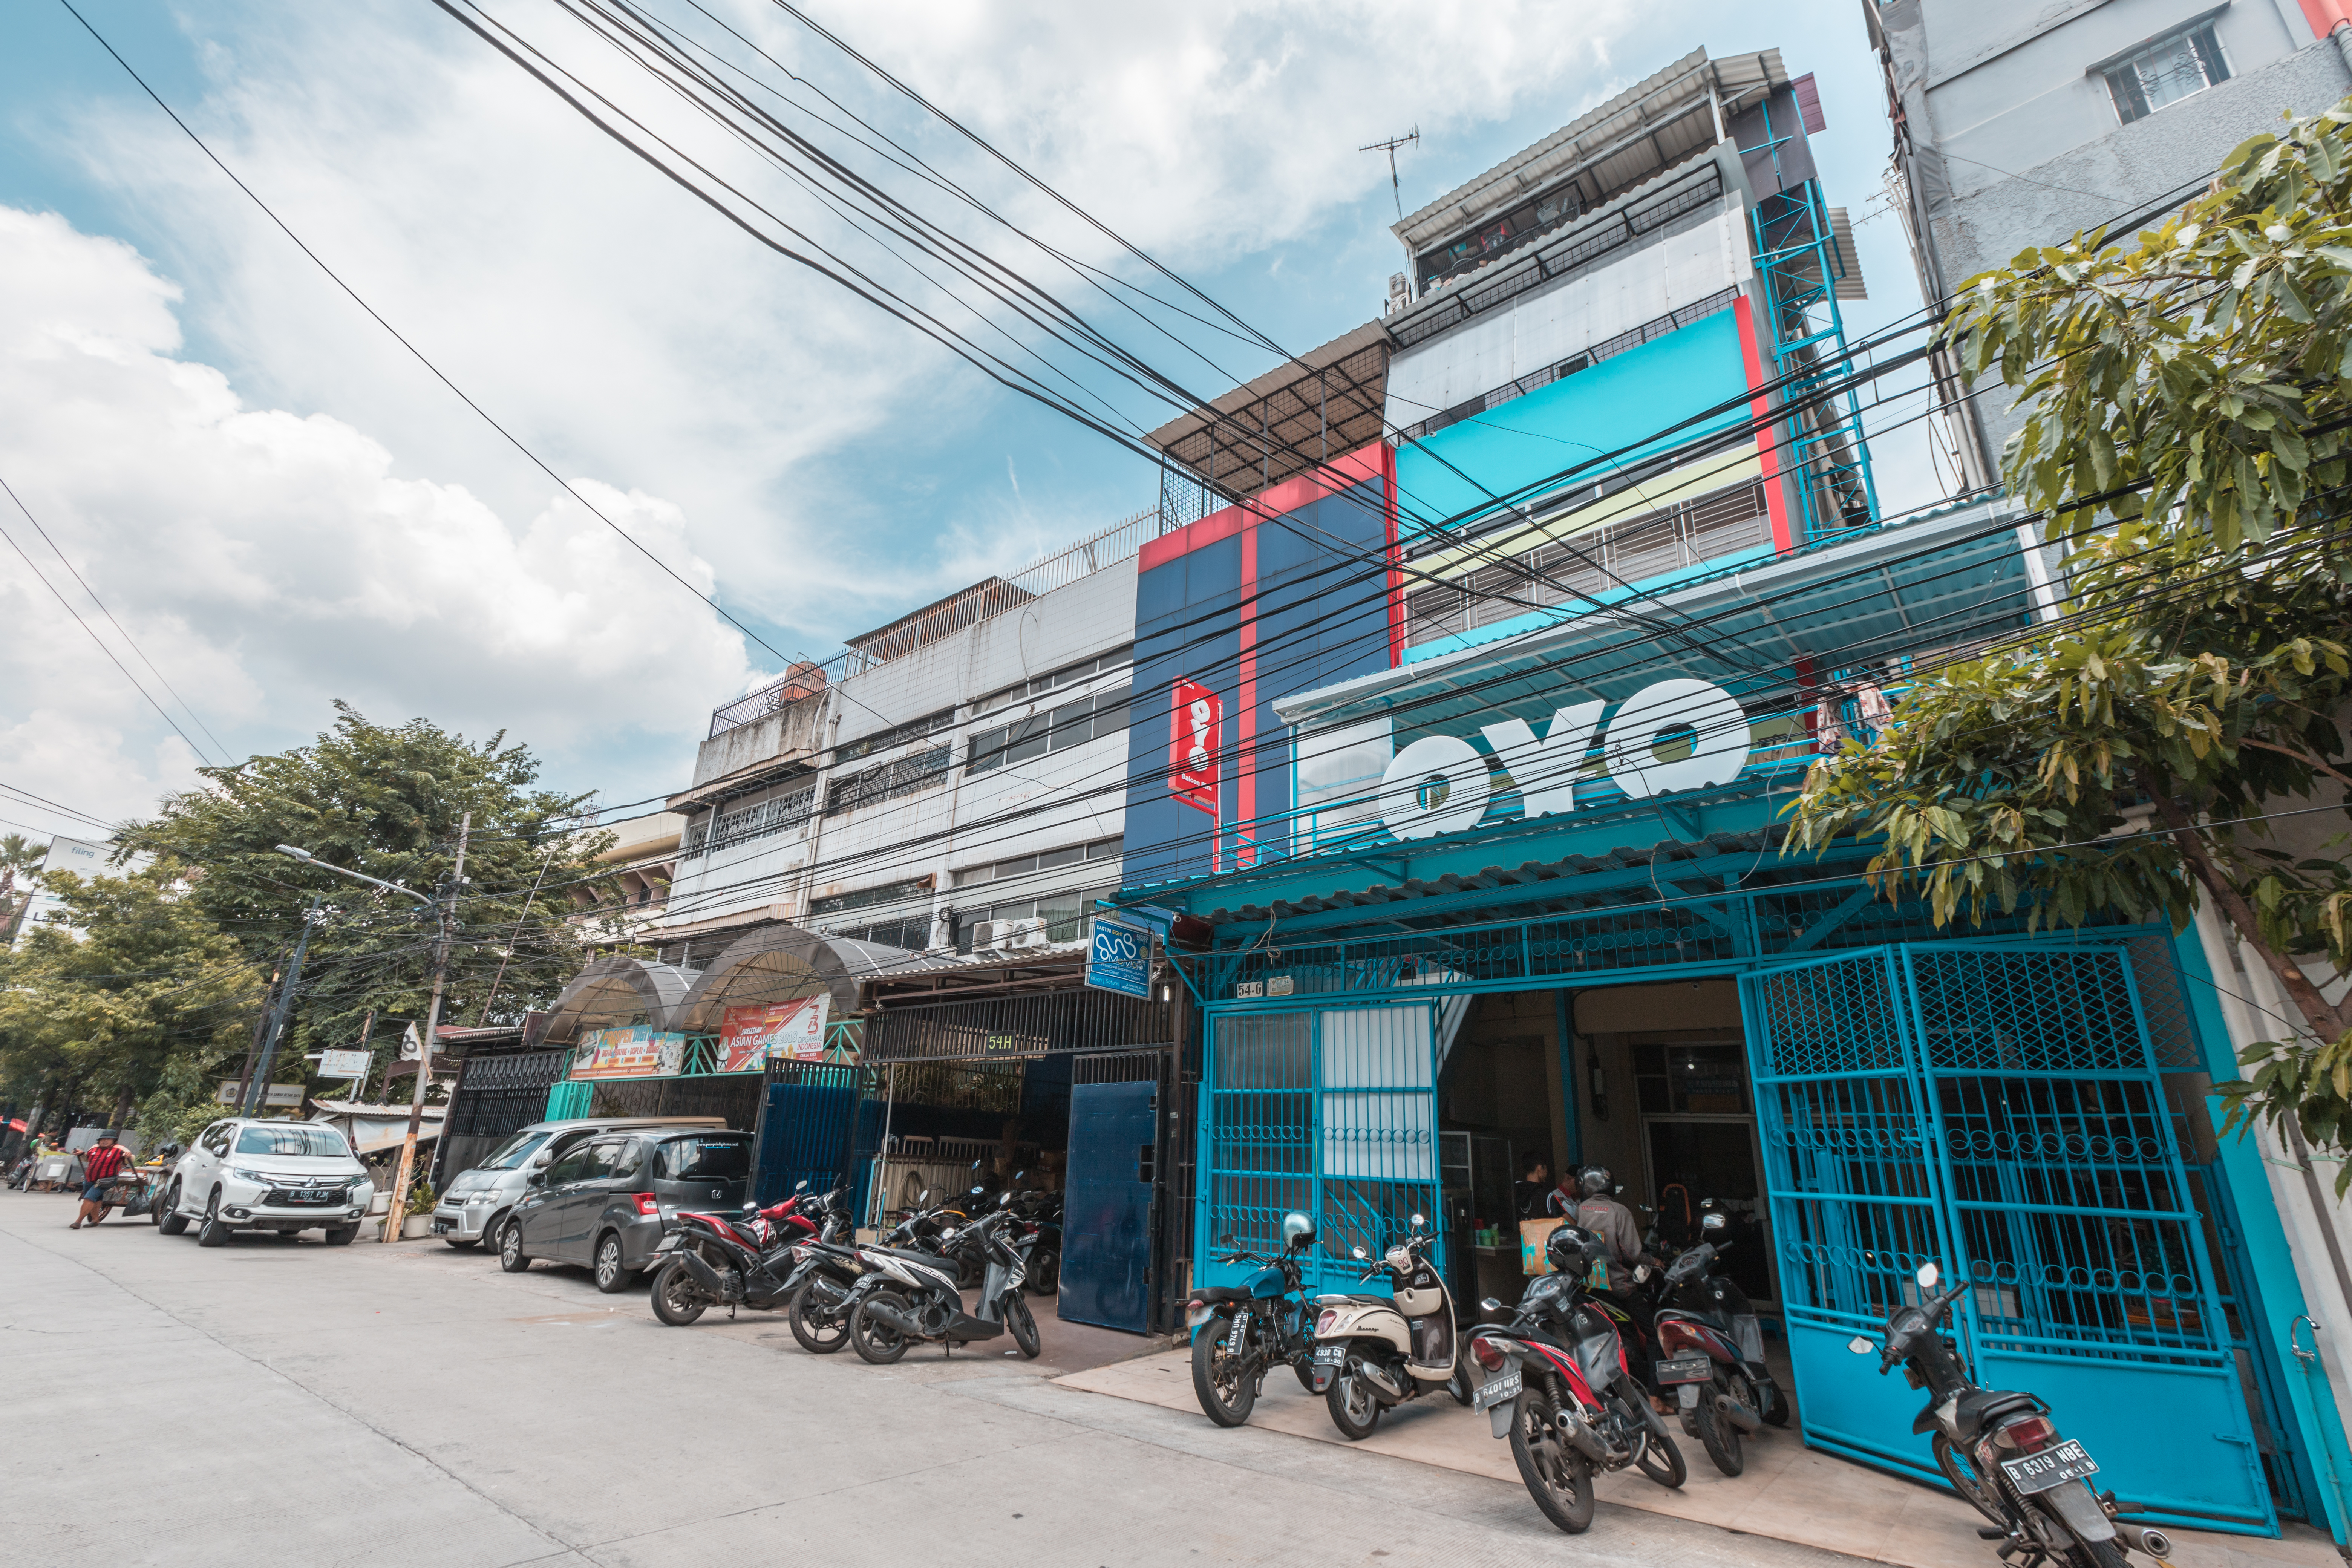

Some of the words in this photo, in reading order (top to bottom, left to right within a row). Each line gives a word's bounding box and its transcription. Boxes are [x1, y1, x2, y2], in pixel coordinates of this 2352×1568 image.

[1189, 698, 1210, 772] OYO
[1379, 678, 1751, 842] OYO
[1182, 773, 1200, 786] Balcon
[71, 847, 95, 858] filing
[1096, 925, 1111, 933] KARTINI
[603, 1028, 634, 1045] PROSPEK
[632, 1025, 666, 1043] DIGITAMA
[741, 1027, 763, 1035] SUKSESKAN
[730, 1036, 752, 1047] ASIAN
[753, 1034, 779, 1046] GAMES
[779, 1031, 798, 1044] 2018
[797, 1042, 821, 1050] INDONESIA
[798, 1035, 823, 1043] DIRGAHAYU
[989, 1035, 1012, 1050] 54.H
[613, 1048, 628, 1056] PRINTING
[916, 1263, 948, 1282] VARIO
[1233, 1315, 1242, 1328] UMS
[1229, 1330, 1238, 1346] 6746
[1475, 1393, 1480, 1403] B
[1483, 1383, 1502, 1396] 6401
[1504, 1375, 1519, 1389] URS
[2007, 1467, 2021, 1480] B
[2022, 1455, 2055, 1475] 6319
[2056, 1443, 2085, 1463] NBE
